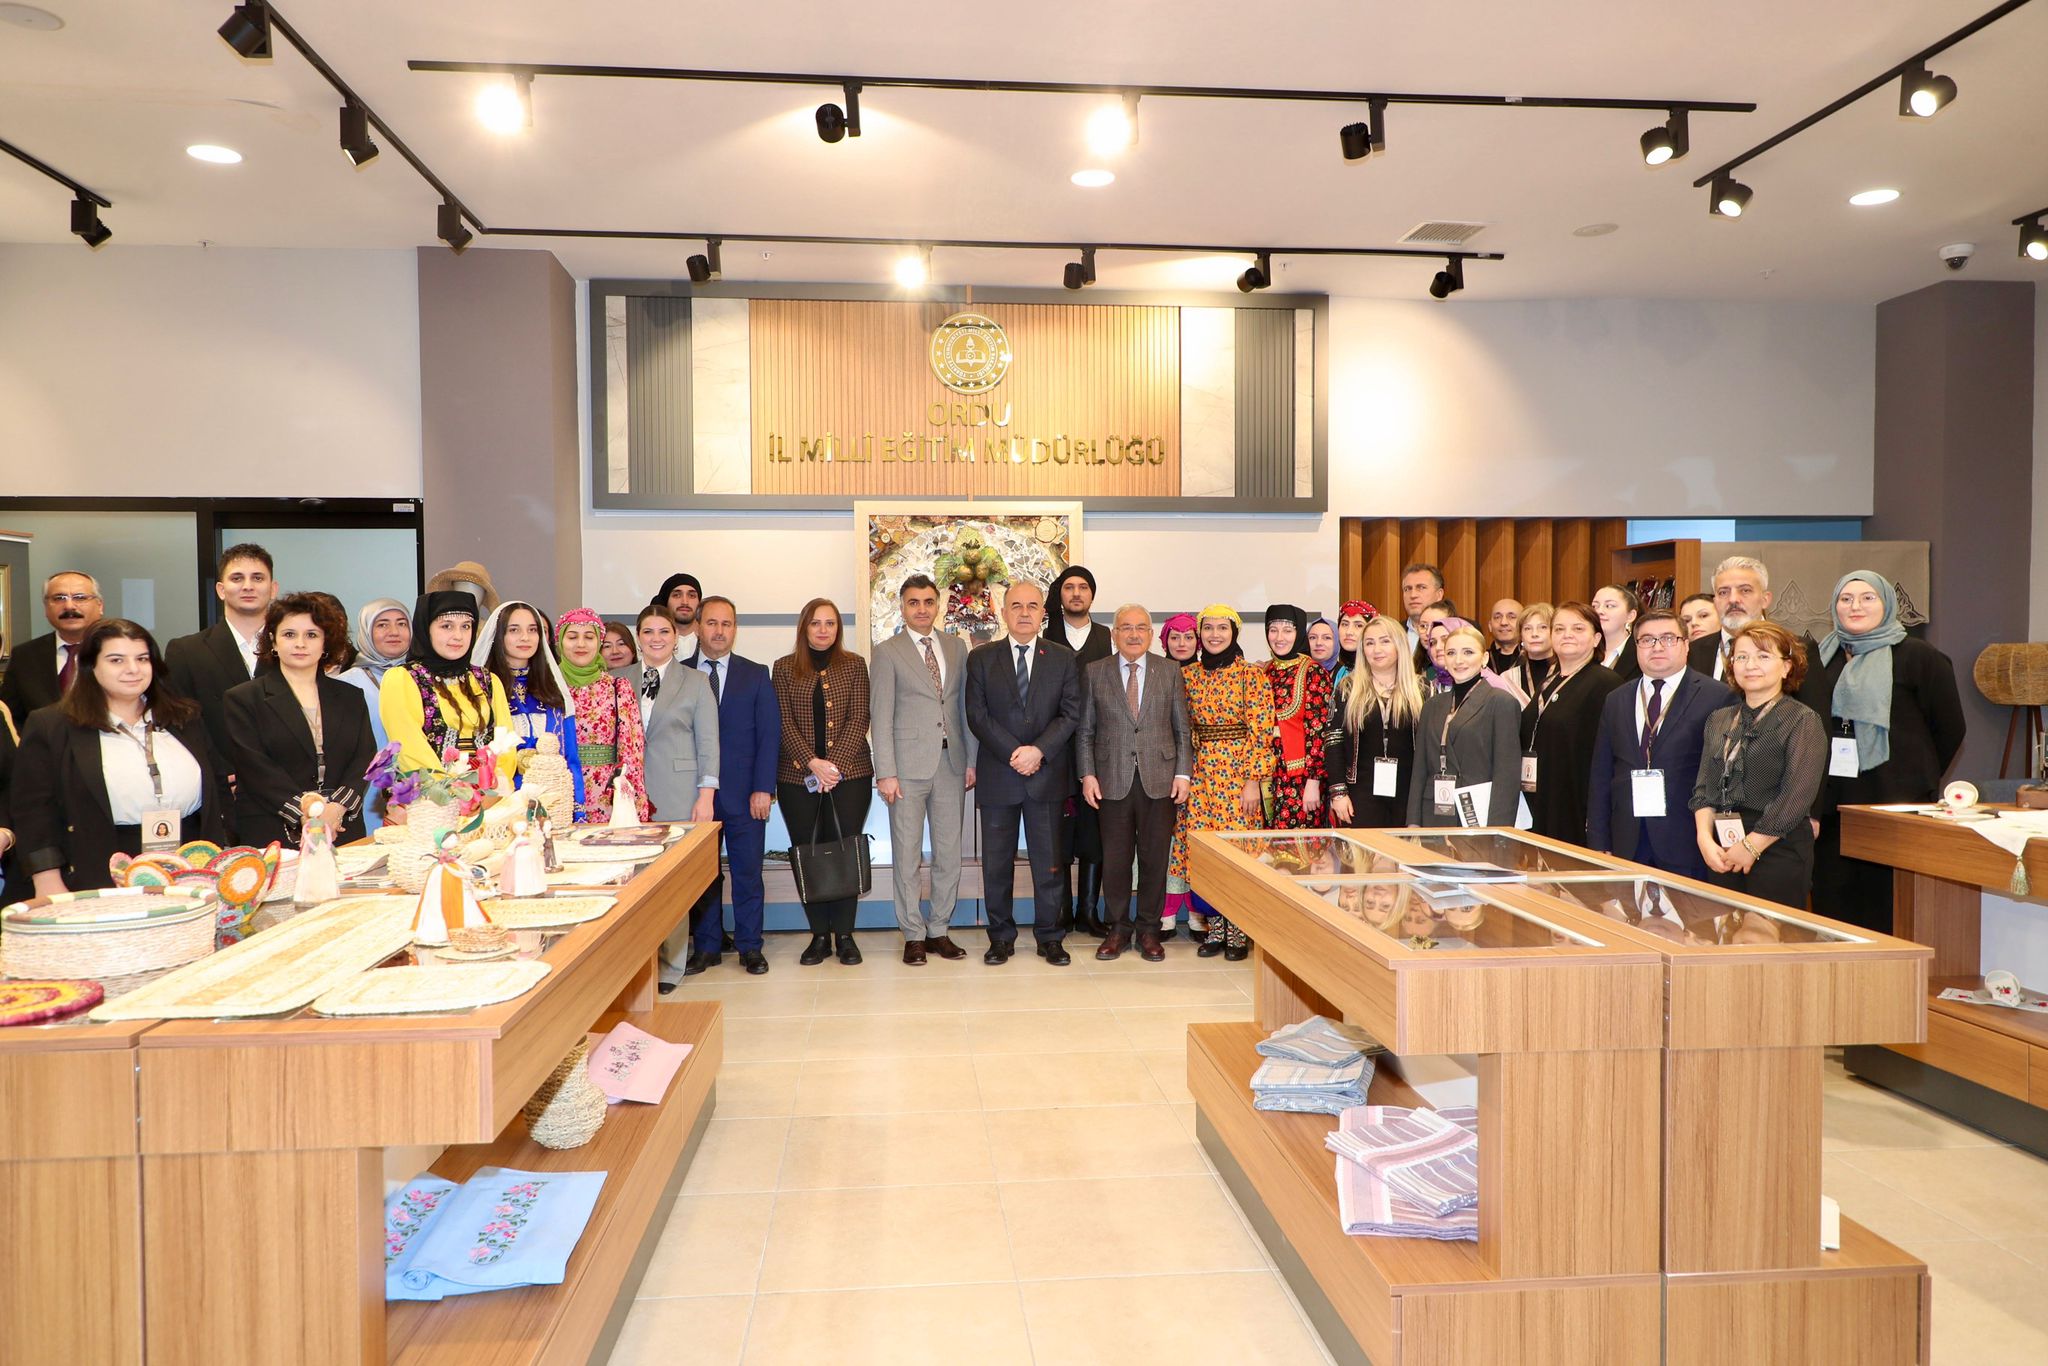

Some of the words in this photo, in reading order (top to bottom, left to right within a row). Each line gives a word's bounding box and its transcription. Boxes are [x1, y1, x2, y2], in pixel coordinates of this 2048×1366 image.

[927, 400, 1011, 428] ORDU
[769, 431, 792, 463] İL
[881, 431, 976, 464] EĞİTİM
[984, 433, 1165, 466] MÜDÜRLÜĞÜ
